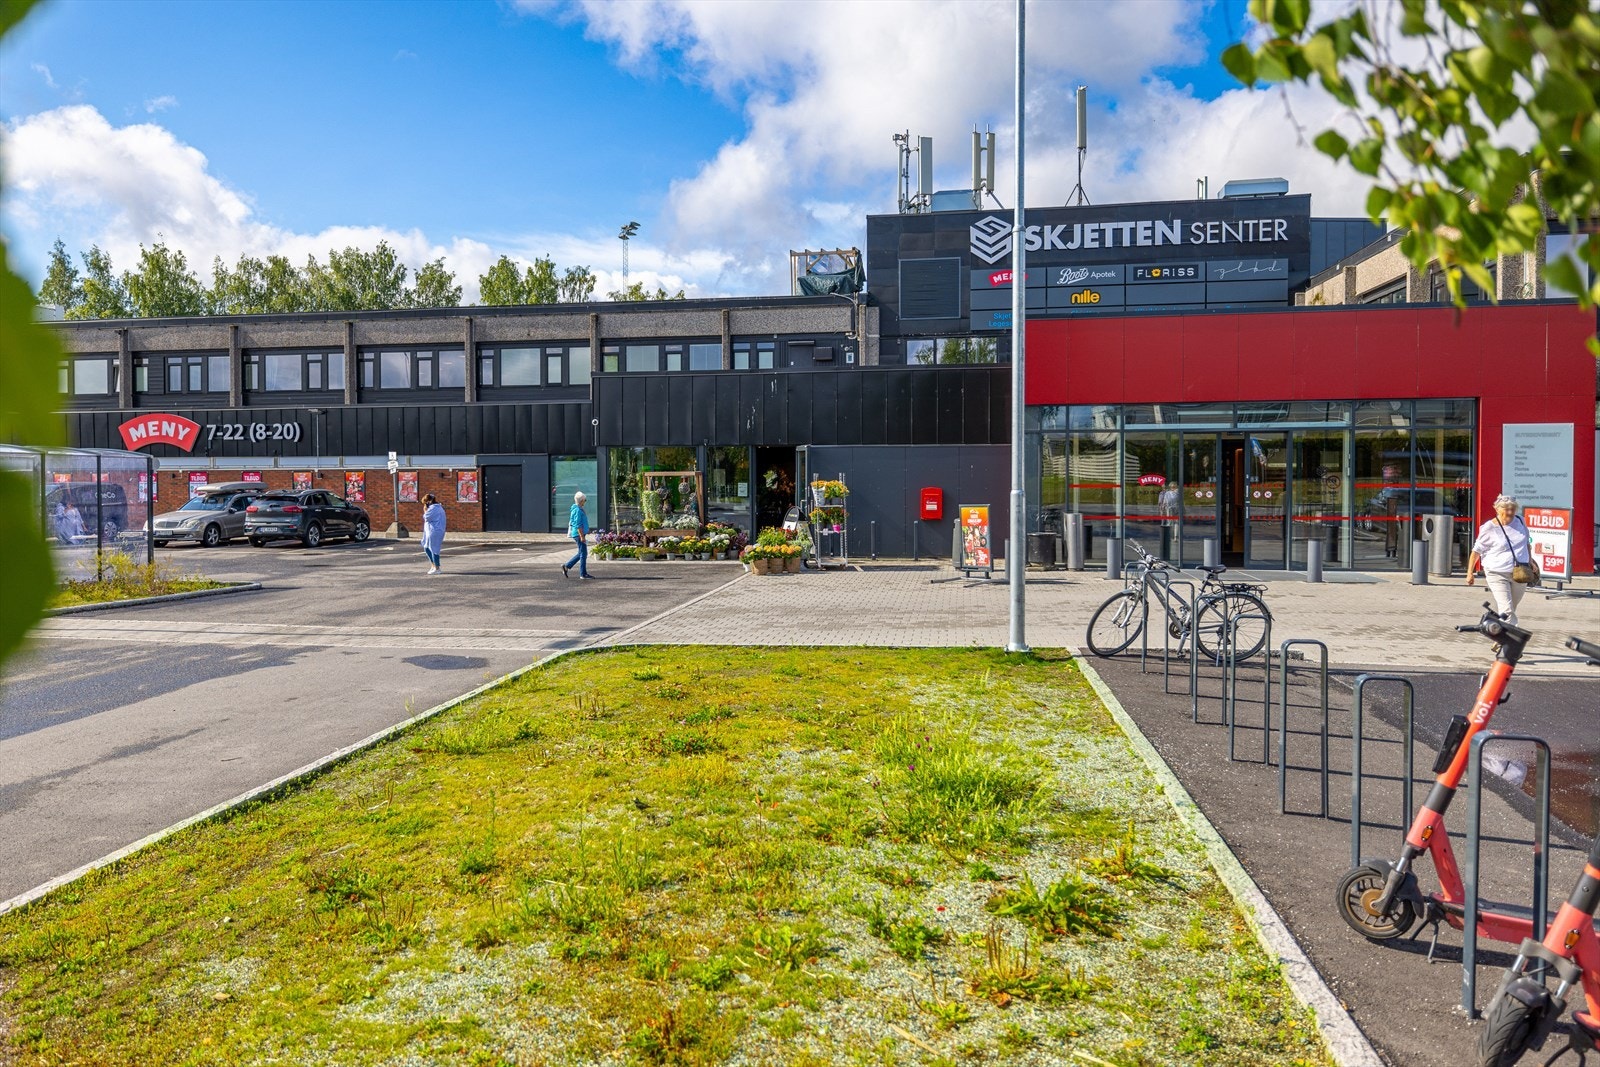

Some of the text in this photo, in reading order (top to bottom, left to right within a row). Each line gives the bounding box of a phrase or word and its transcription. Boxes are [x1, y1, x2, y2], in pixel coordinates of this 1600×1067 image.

[1025, 218, 1288, 252] SKJETTEN SENTER
[1056, 267, 1116, 285] Boots Apotek
[1137, 266, 1195, 279] FLORISS
[1071, 289, 1100, 304] nille
[128, 420, 192, 443] MENY
[206, 421, 301, 443] 7-22 (8-20)
[1141, 476, 1163, 484] MENY
[1528, 514, 1565, 528] TILBUD
